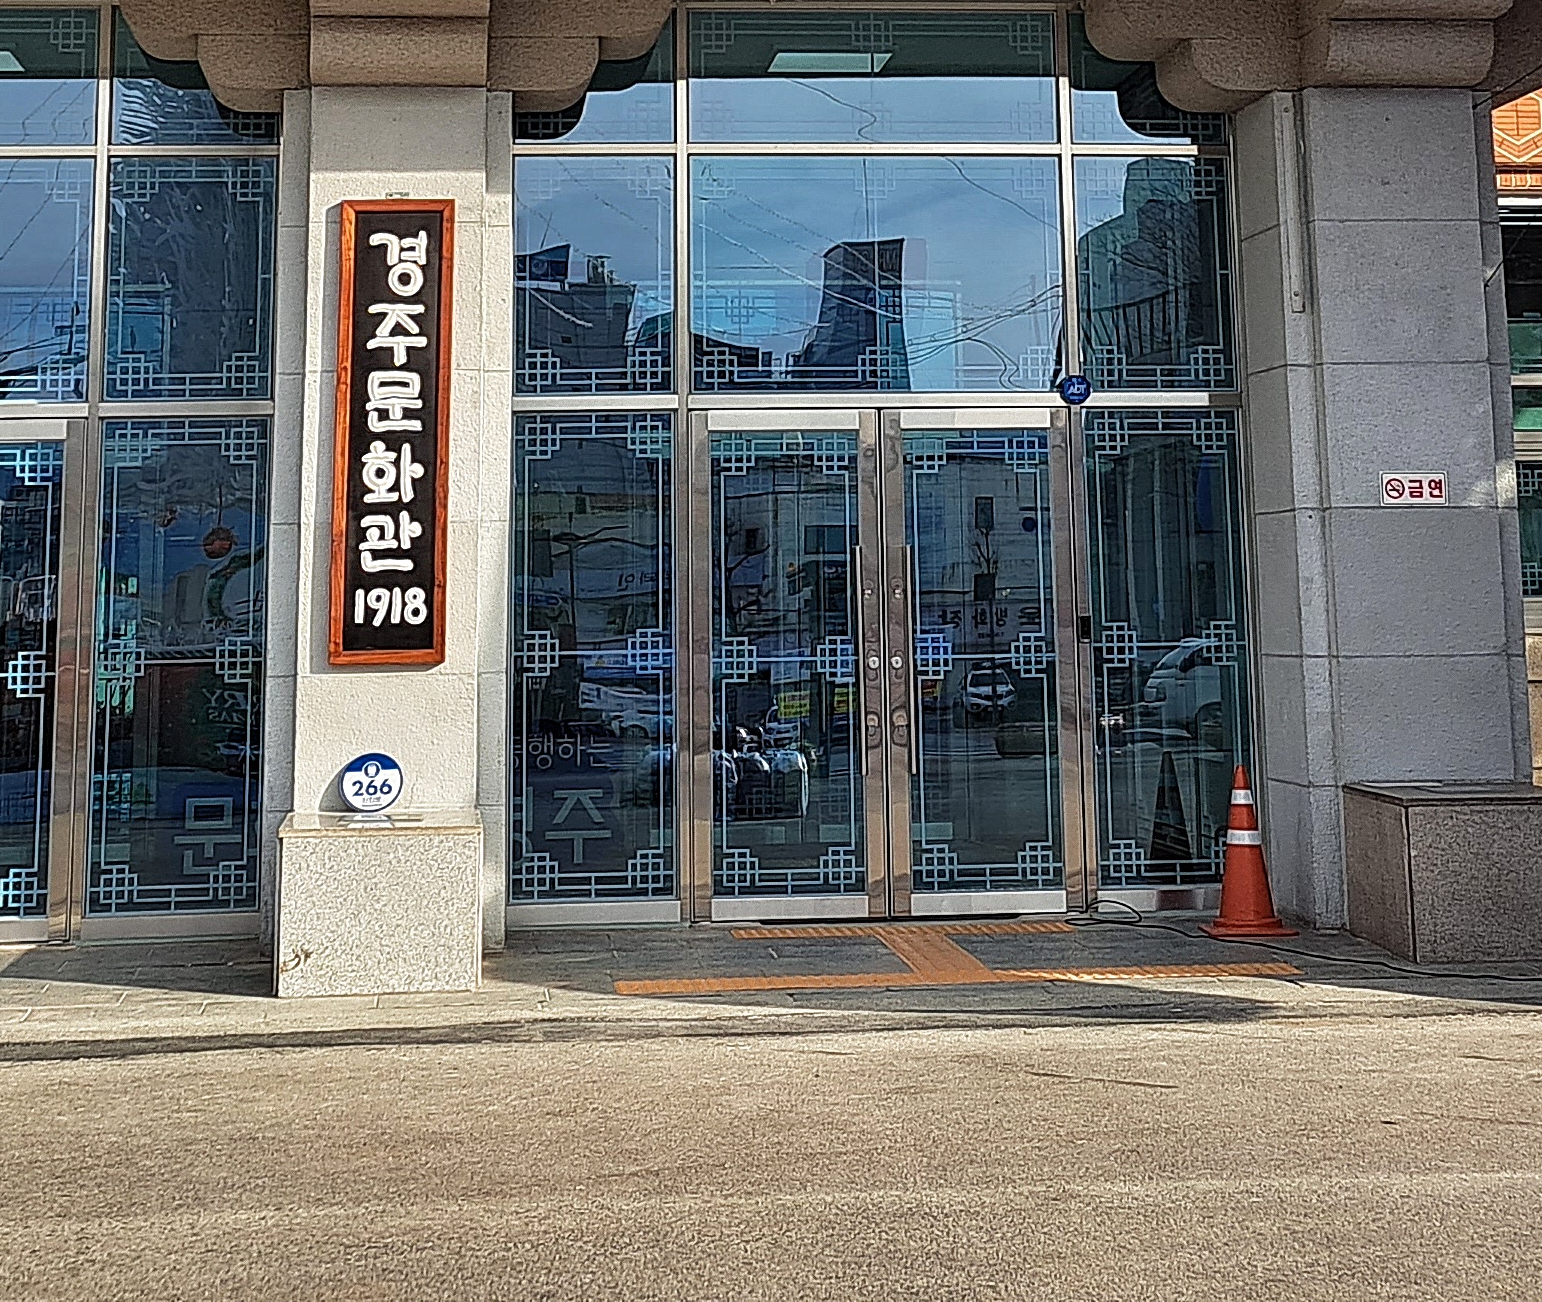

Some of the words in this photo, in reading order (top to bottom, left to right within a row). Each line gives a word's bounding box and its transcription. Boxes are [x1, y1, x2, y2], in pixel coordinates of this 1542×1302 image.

[1067, 383, 1087, 395] ADT
[358, 230, 429, 574] 경주문화관
[1408, 478, 1444, 499] 금연
[353, 586, 428, 628] 1918
[351, 778, 393, 797] 266
